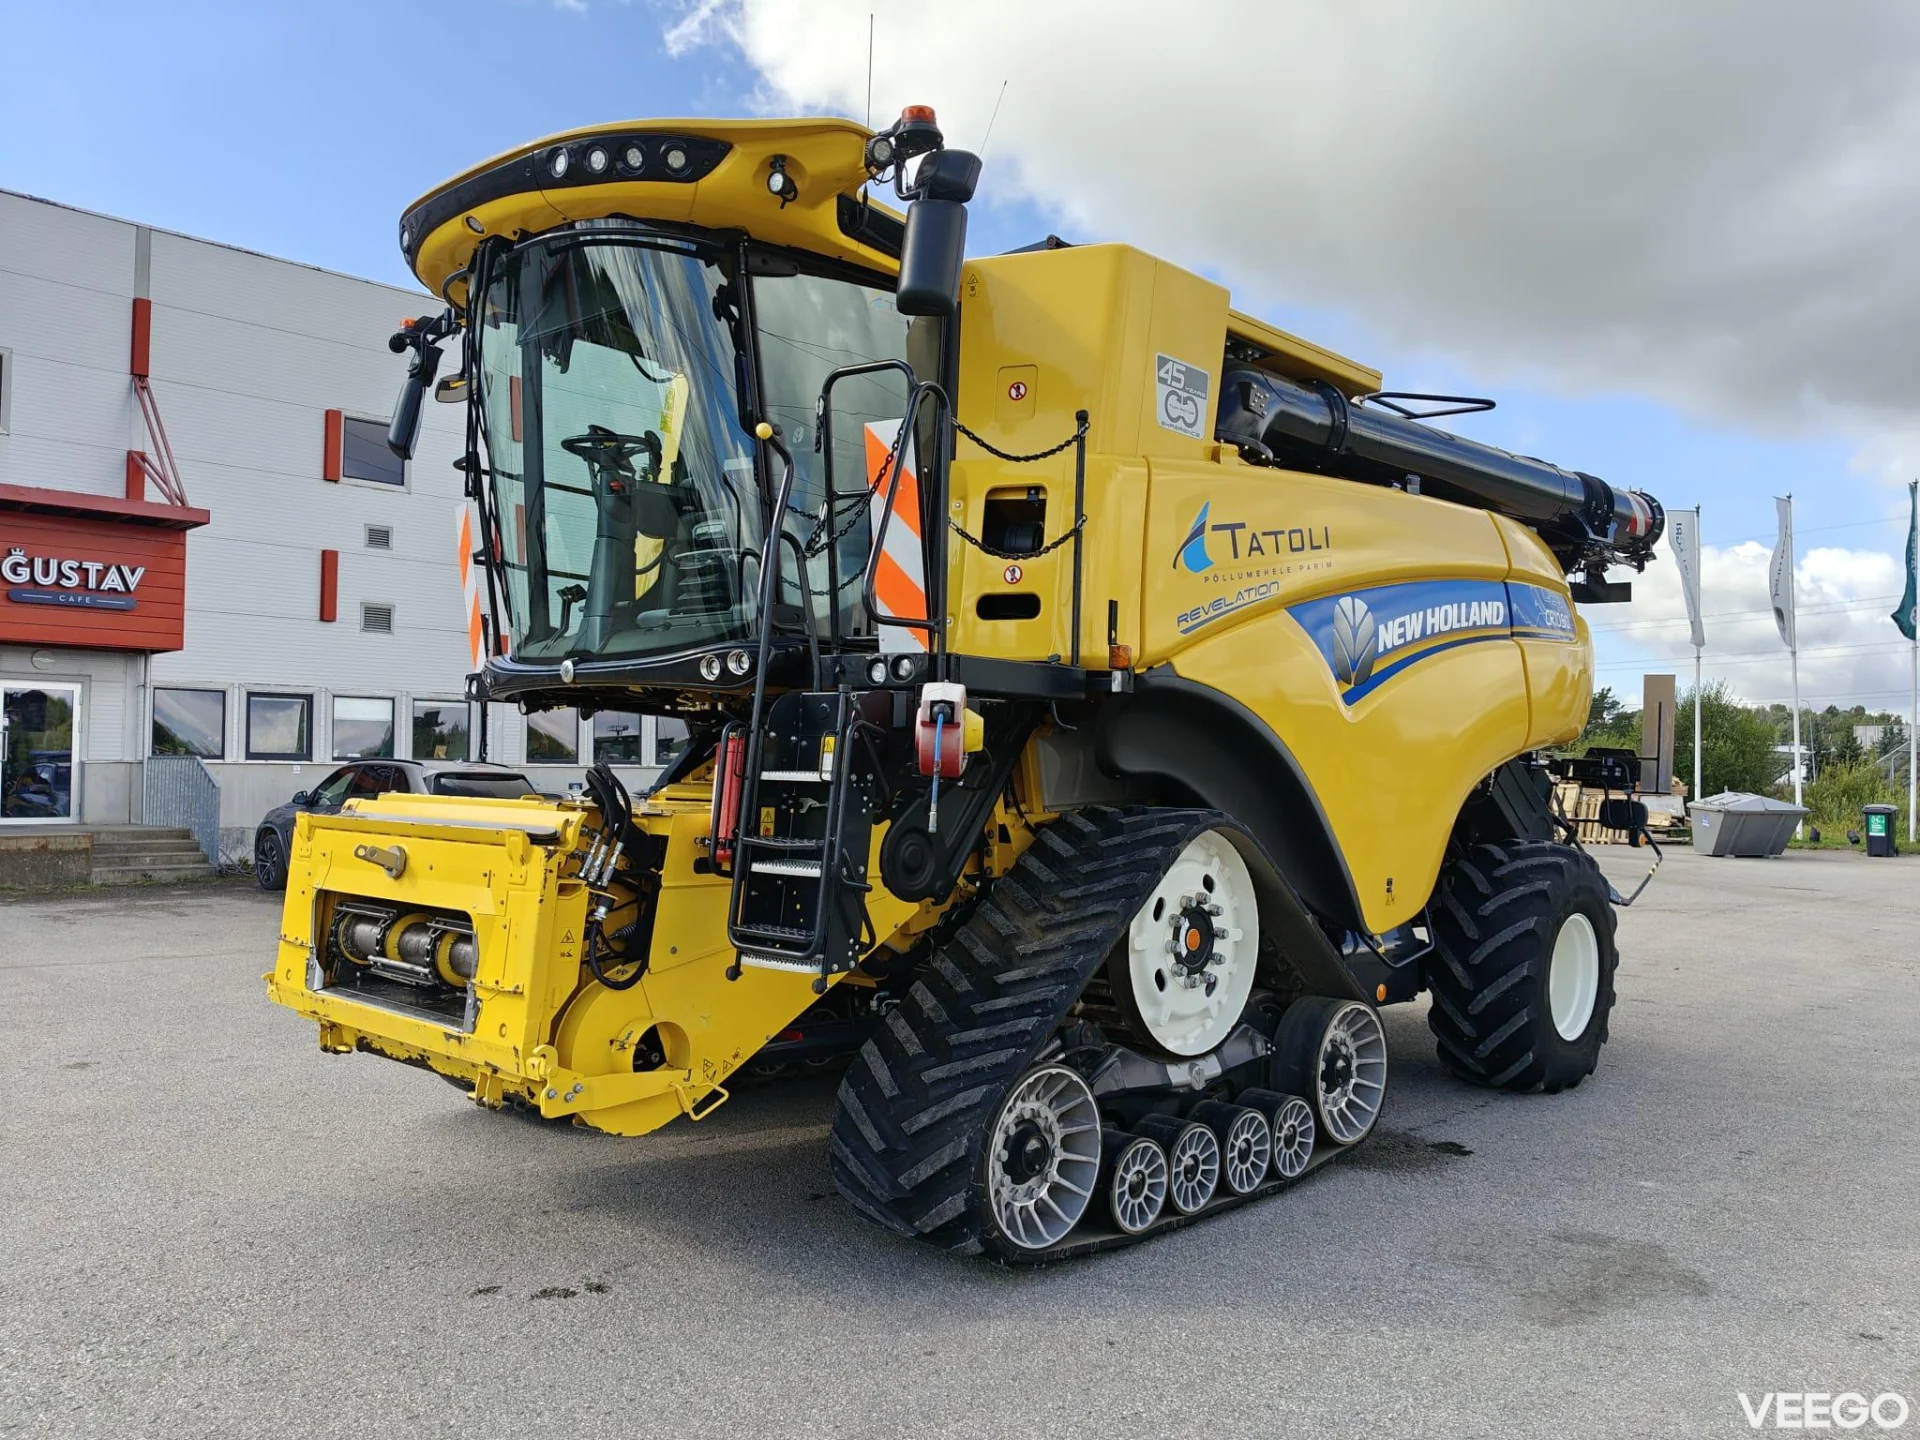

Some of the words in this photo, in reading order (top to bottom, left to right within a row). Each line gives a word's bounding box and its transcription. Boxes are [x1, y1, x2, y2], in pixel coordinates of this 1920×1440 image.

[1158, 360, 1186, 389] 45
[1211, 522, 1330, 560] TATOLI
[1, 554, 145, 592] GUSTAV
[58, 594, 91, 604] CAFE
[1177, 580, 1280, 628] REVELATION
[1378, 610, 1424, 653] NEW
[1426, 601, 1505, 636] HOLLAND
